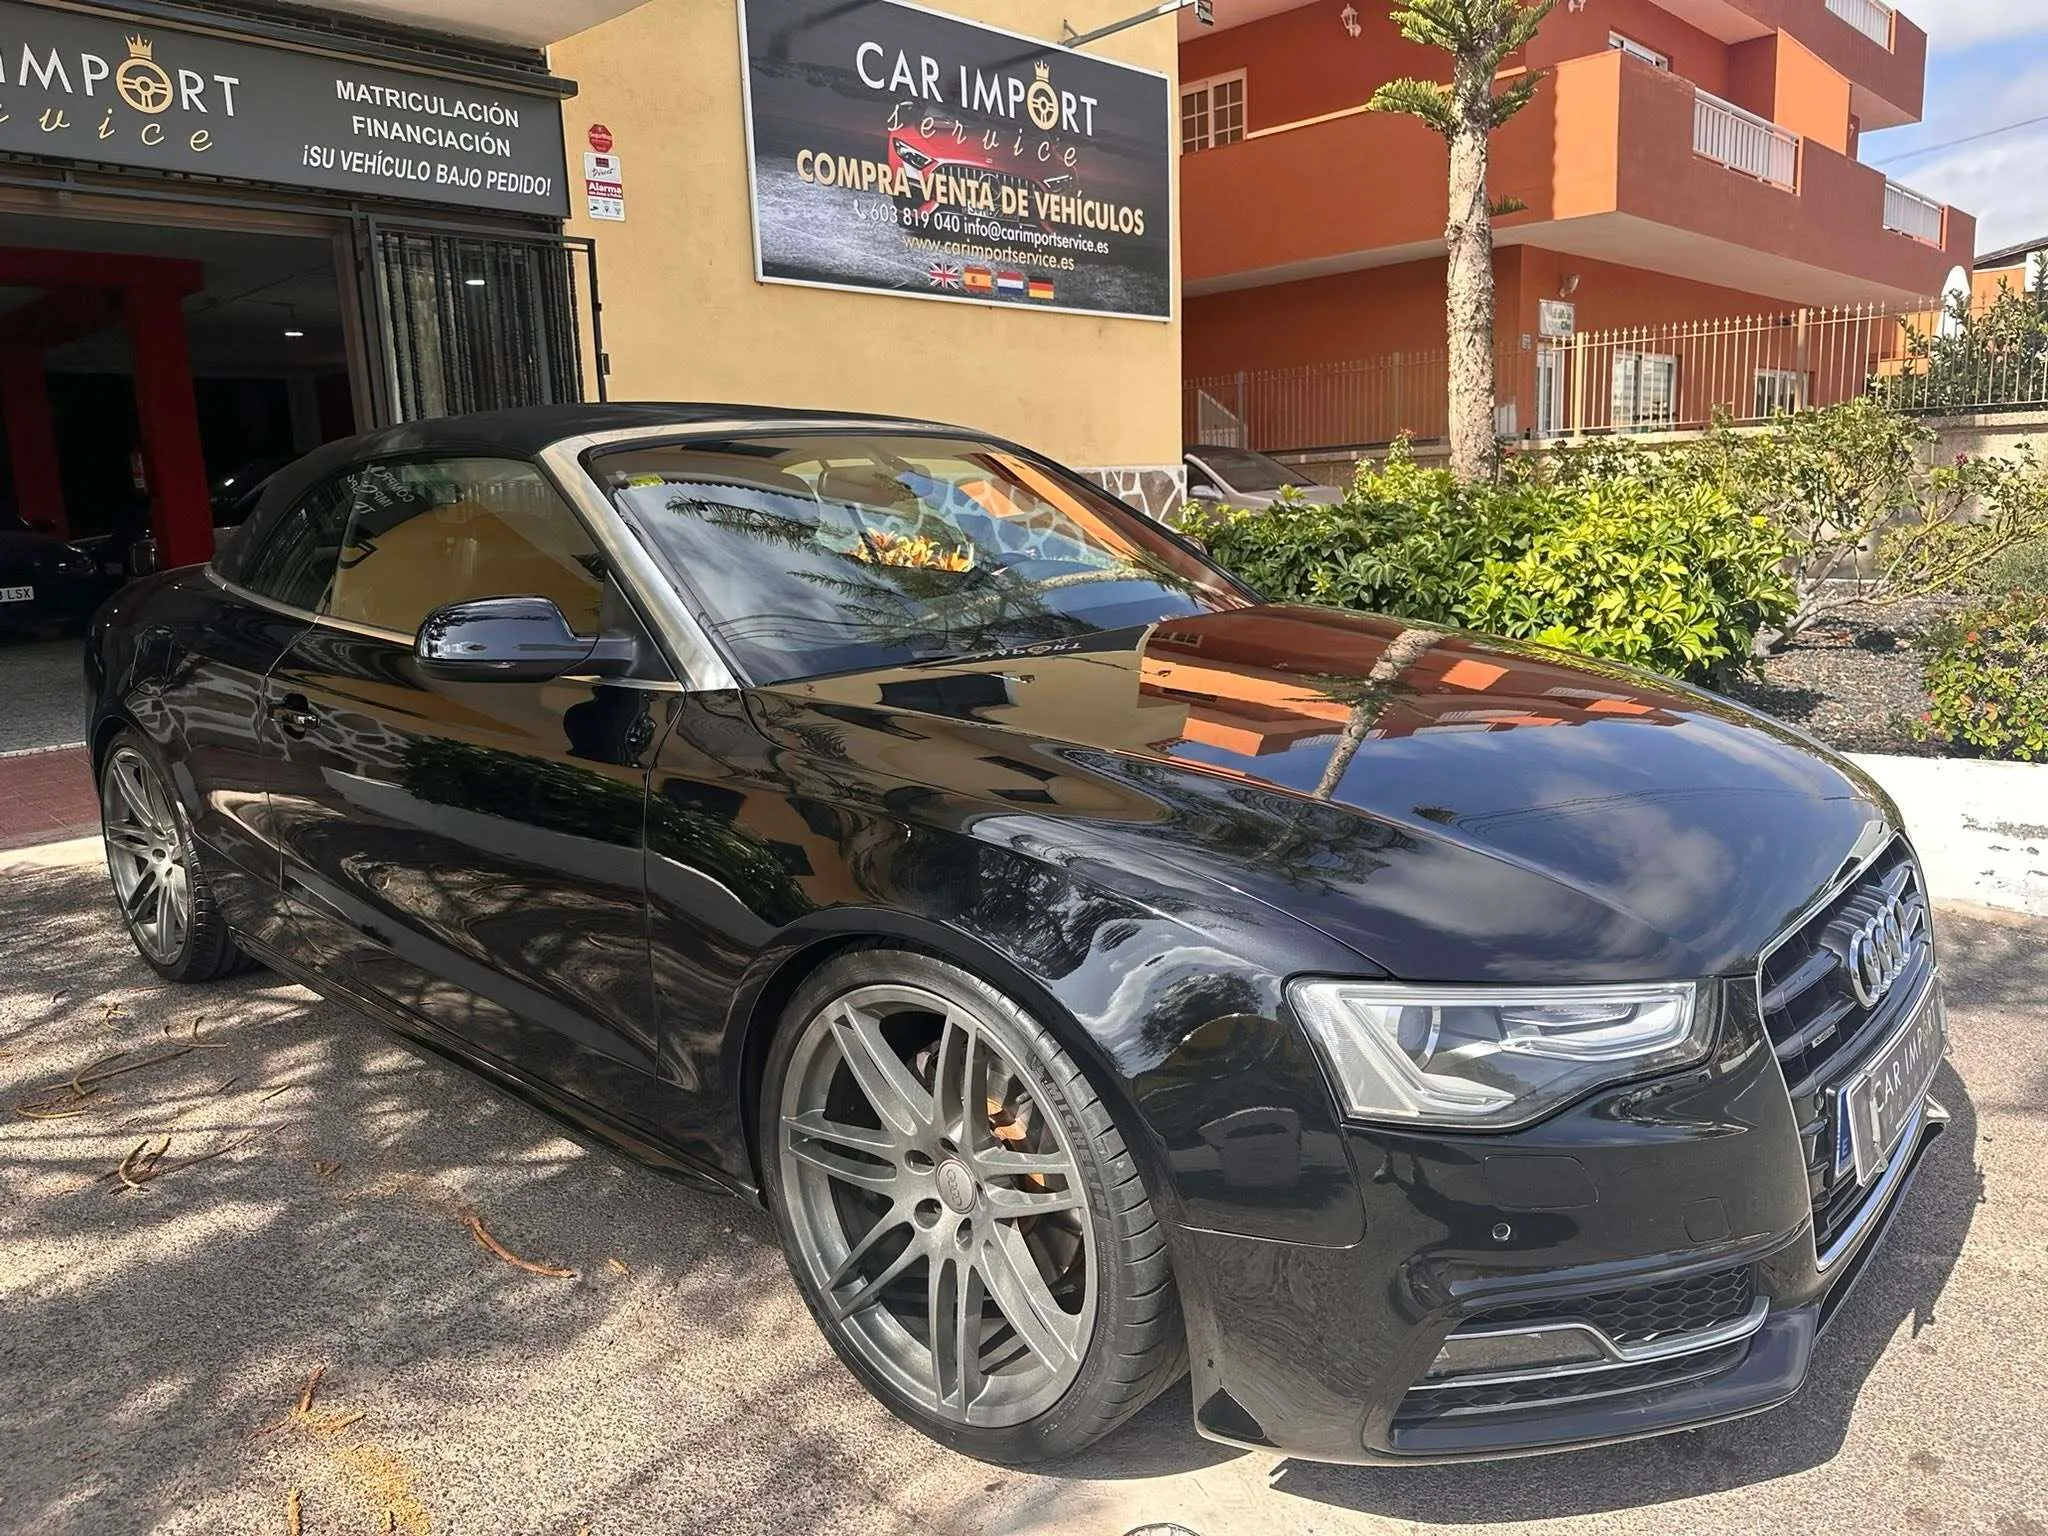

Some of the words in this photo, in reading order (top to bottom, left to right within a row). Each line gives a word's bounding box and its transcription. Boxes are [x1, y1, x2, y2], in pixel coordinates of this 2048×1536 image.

[0, 43, 239, 117] MPORT
[336, 79, 519, 128] MATRICULACIÓN
[856, 41, 943, 103] CAR
[960, 65, 1098, 136] IMPORT
[0, 103, 213, 151] vice
[352, 115, 511, 157] FINANCIACIÓN
[302, 144, 335, 169] ¡SU
[340, 150, 430, 181] VEHÍCULO
[436, 163, 482, 189] BAJO
[486, 170, 552, 196] PEDIDO!
[589, 182, 622, 194] Alarma
[796, 149, 911, 198] COMPRA
[918, 171, 995, 212] VENTA
[1001, 184, 1029, 218] DE
[1034, 190, 1145, 236] VEHÍCULOS
[870, 203, 898, 223] 603
[903, 208, 929, 227] 819
[934, 213, 960, 232] 040
[964, 217, 1109, 254] info@carimportservice.es
[902, 235, 1075, 271] www.carimportservice.es
[7, 588, 31, 600] LSX
[1872, 1060, 1902, 1113] CAR
[1904, 998, 1938, 1075] IMPORT
